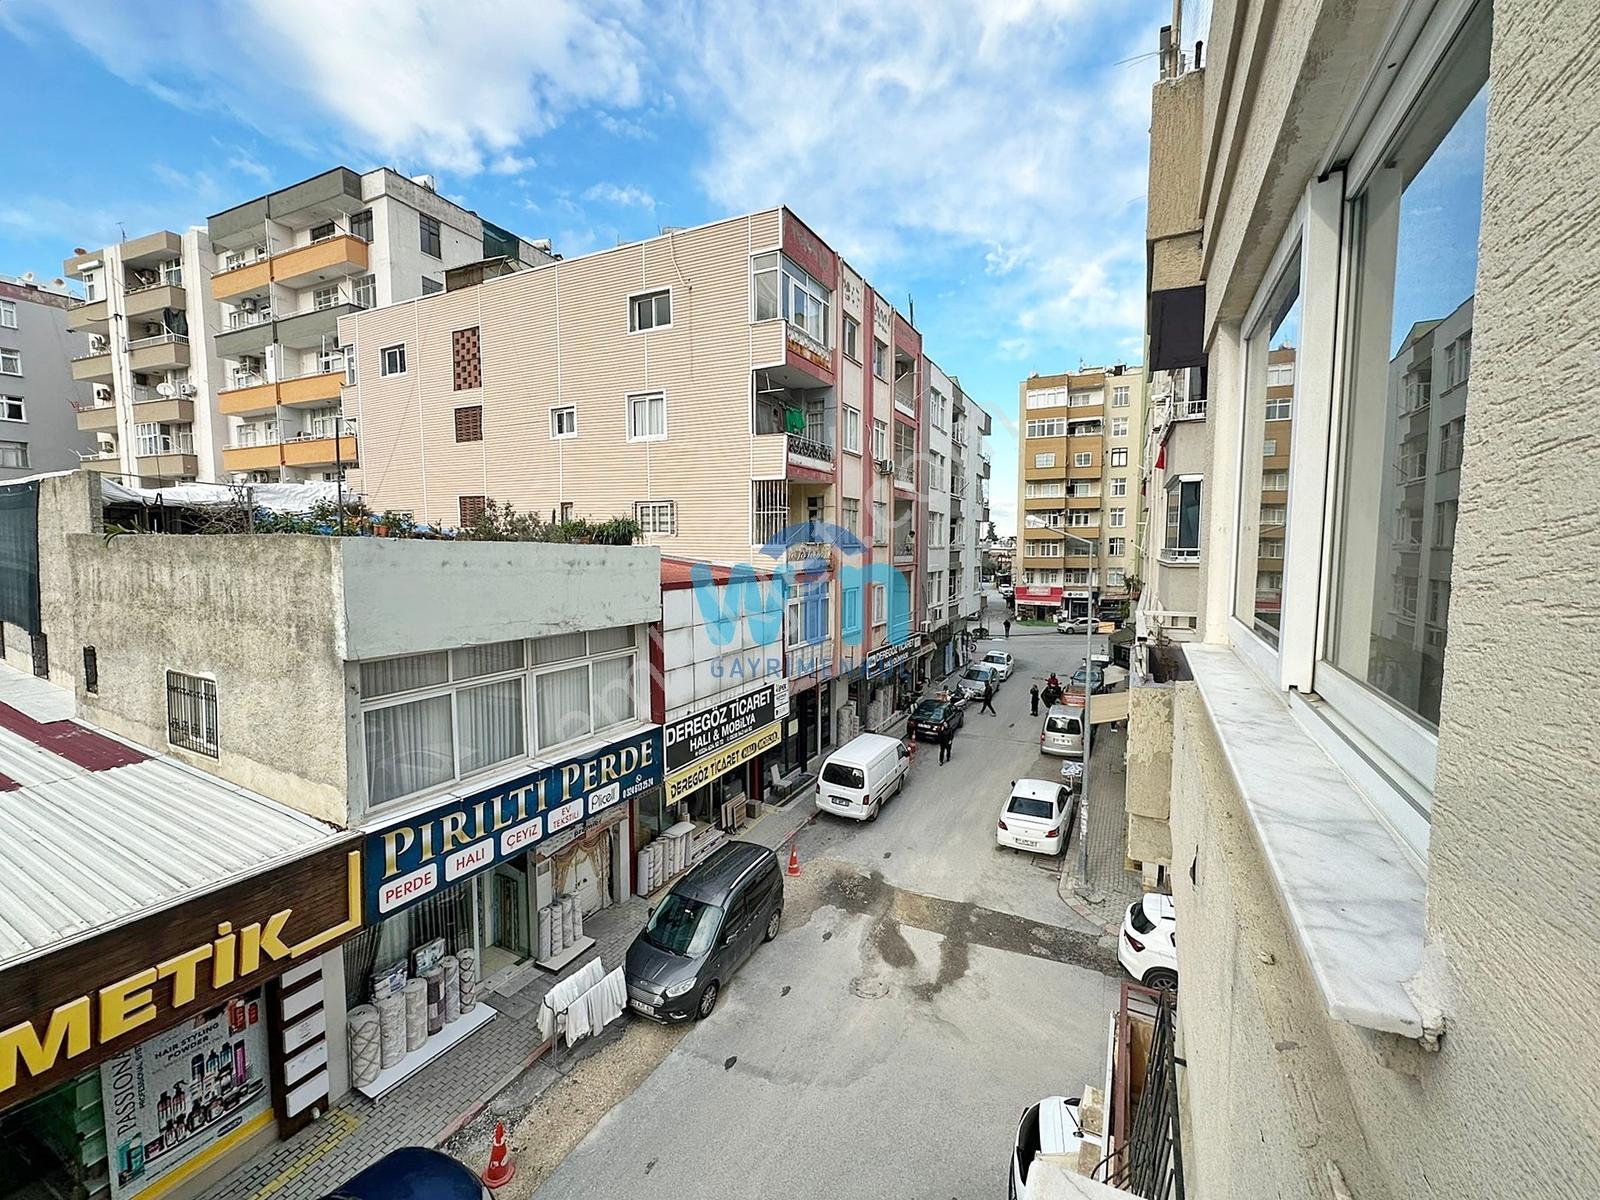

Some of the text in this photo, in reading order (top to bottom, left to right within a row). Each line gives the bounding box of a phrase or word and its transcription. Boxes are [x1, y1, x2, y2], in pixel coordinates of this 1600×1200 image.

[665, 705, 728, 747] DEREGÖZ
[728, 689, 772, 719] TİCARET
[689, 732, 711, 752] HALI
[713, 729, 720, 741] &
[670, 766, 709, 799] DEREGÖZ
[710, 749, 740, 776] TİCARET
[381, 739, 653, 879] PIRILTI PERDE
[561, 805, 571, 816] EV
[506, 824, 539, 847] ÇEYİZ
[456, 848, 485, 871] HALI
[385, 873, 432, 904] PERDE
[154, 1043, 180, 1060] HAIR
[180, 1022, 219, 1046] STYLING
[167, 1035, 209, 1061] POWDER
